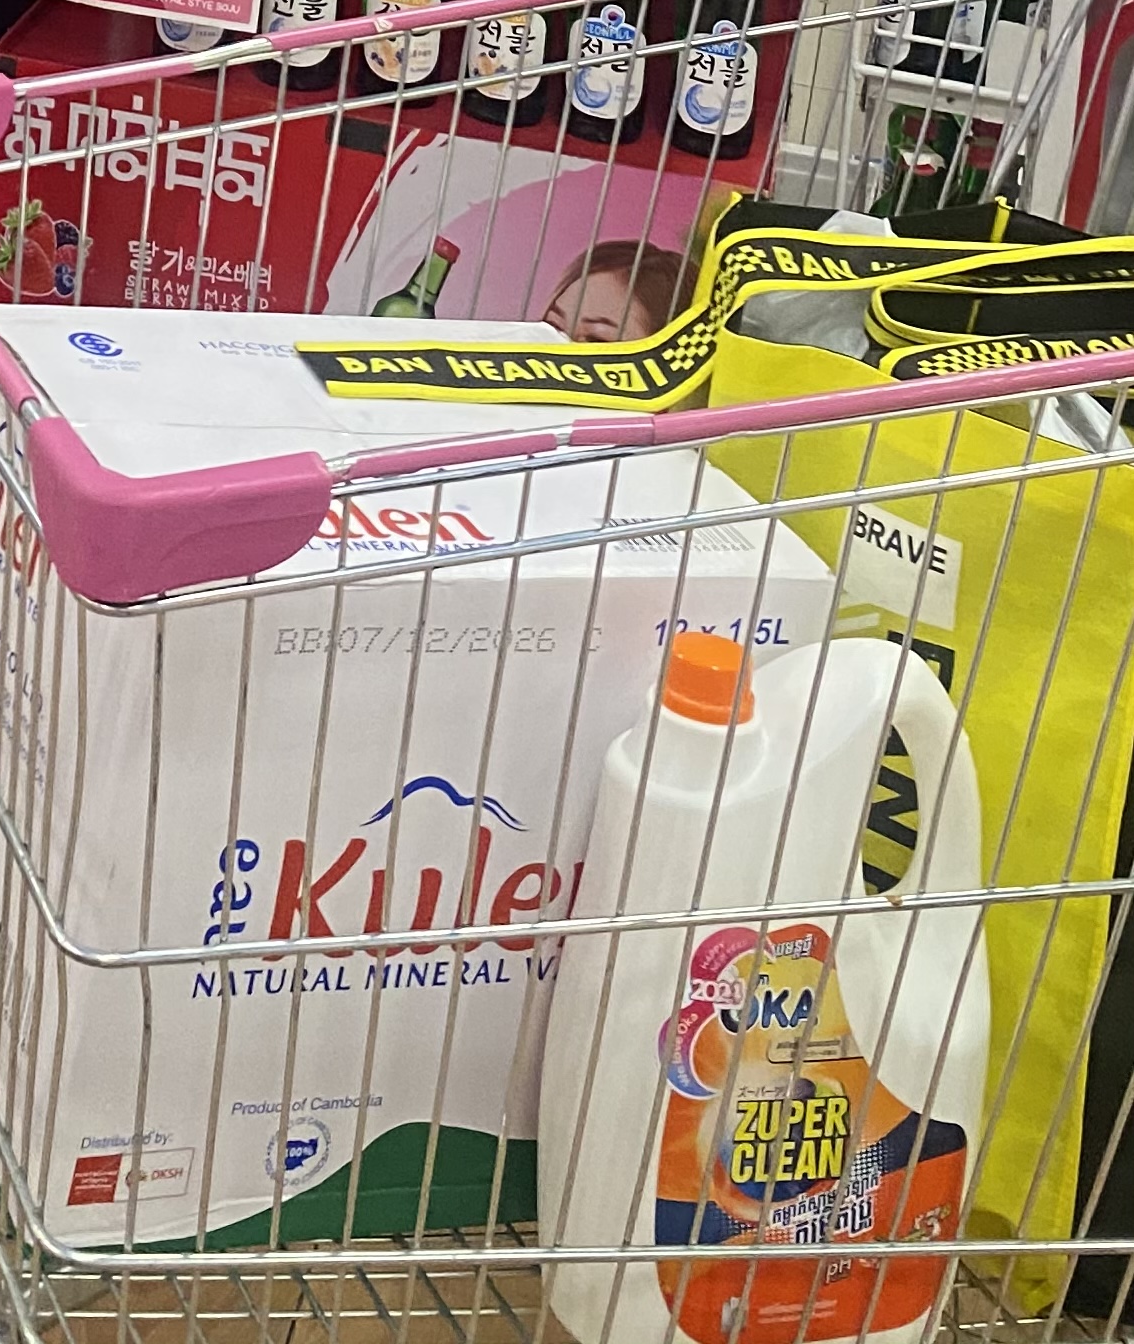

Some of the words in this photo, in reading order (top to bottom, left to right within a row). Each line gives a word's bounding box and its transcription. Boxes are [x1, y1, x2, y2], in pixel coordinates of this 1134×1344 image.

[216, 1, 241, 15] SOJU
[687, 52, 750, 89] 선물
[772, 245, 860, 280] BAN
[204, 288, 270, 310] MIXD
[336, 356, 434, 374] BAN
[446, 355, 594, 385] HEANG
[605, 368, 634, 388] 97
[314, 496, 495, 541] ulen
[853, 510, 947, 575] BRAVE
[728, 616, 790, 646] 15L
[262, 825, 585, 961] Kule
[192, 965, 352, 999] NATURAL
[677, 1012, 699, 1034] Oka
[719, 987, 819, 1034] OKA
[231, 1100, 290, 1116] Produc
[292, 1098, 307, 1112] of
[310, 1094, 383, 1111] Camboia
[734, 1097, 849, 1142] ZUPER
[730, 1137, 845, 1184] CLEAN
